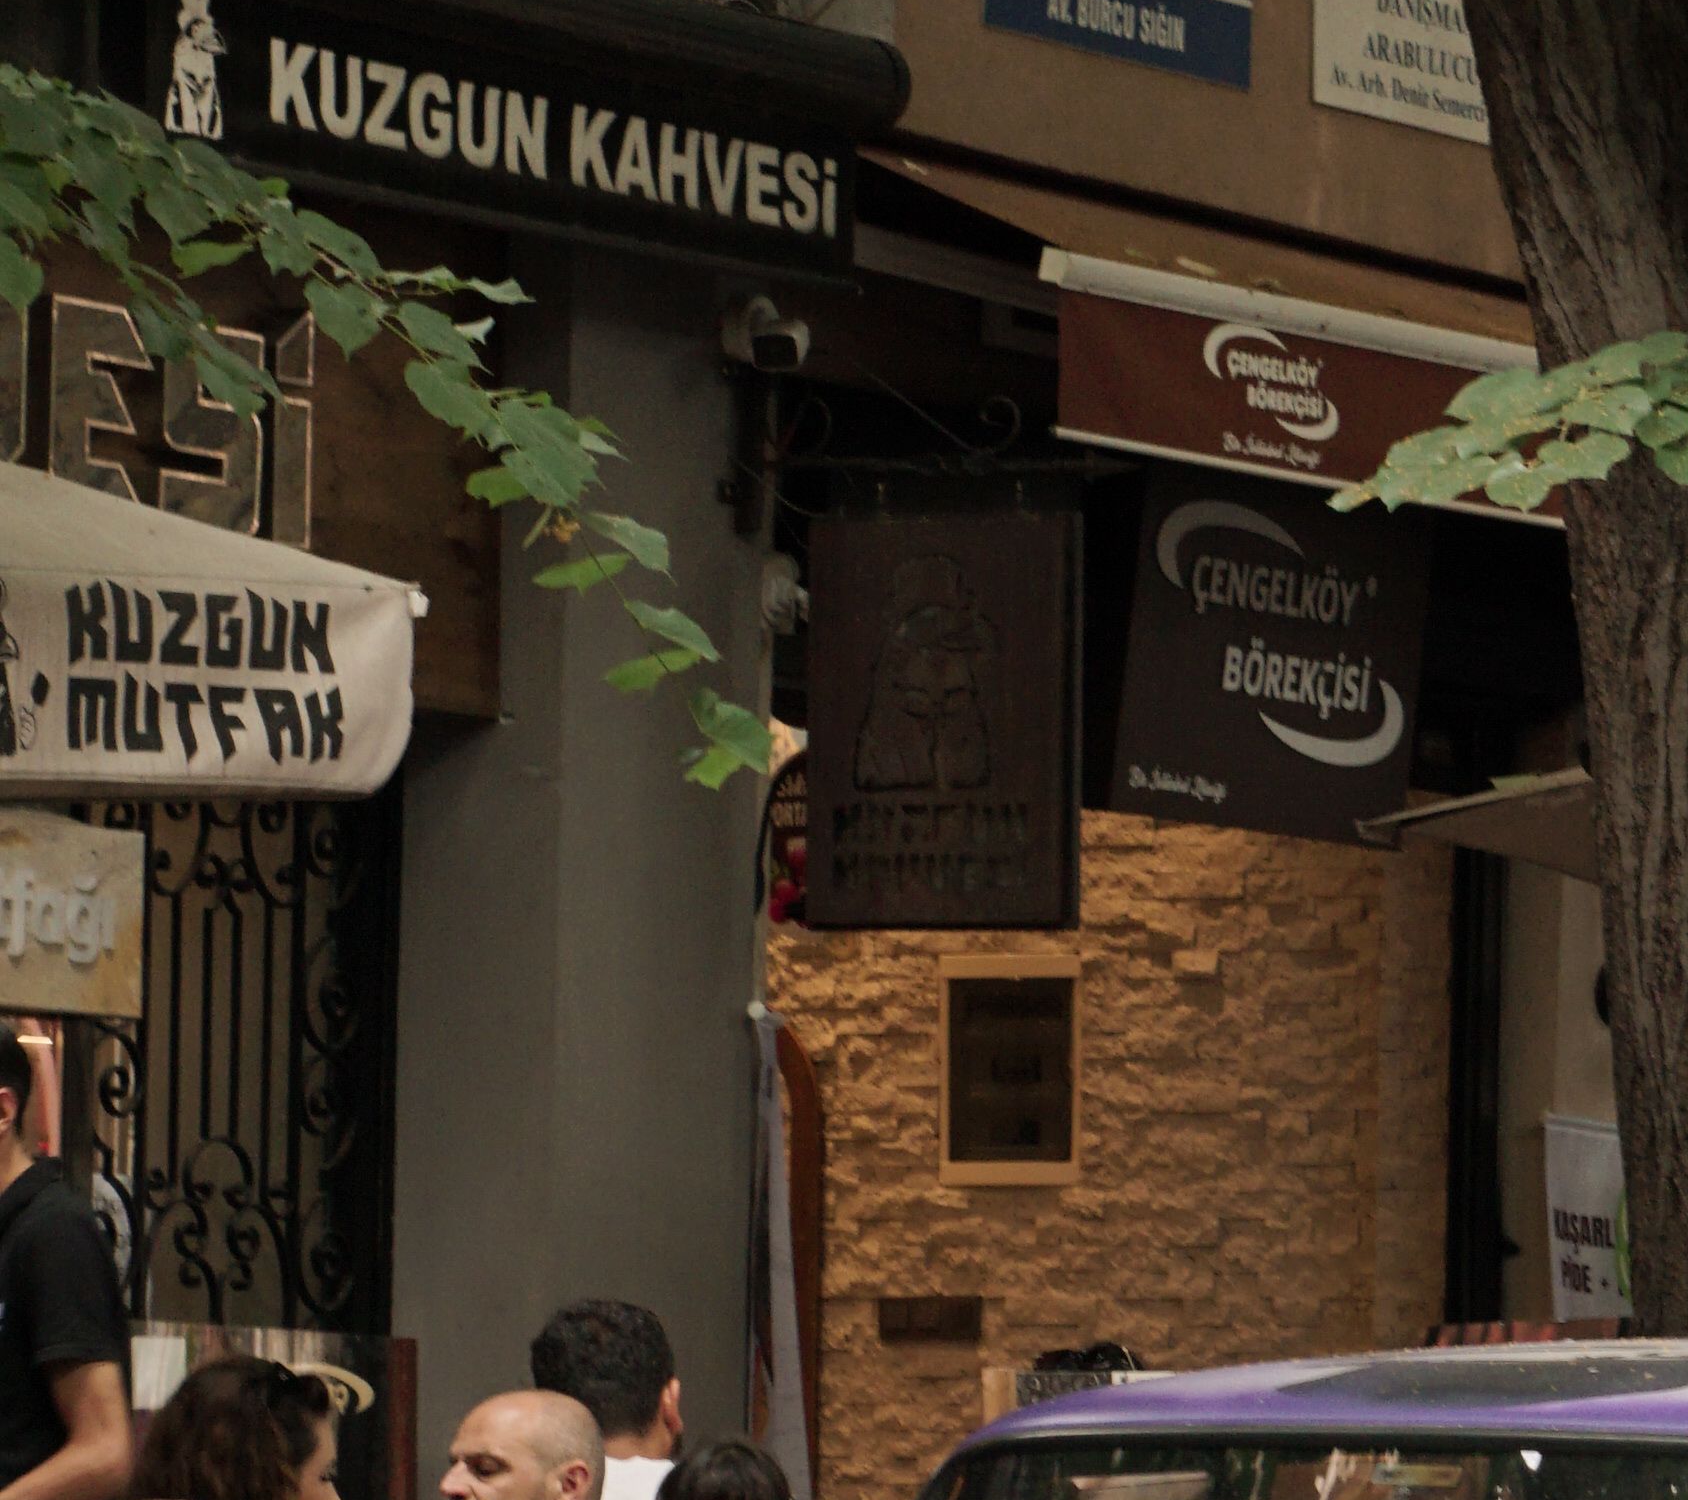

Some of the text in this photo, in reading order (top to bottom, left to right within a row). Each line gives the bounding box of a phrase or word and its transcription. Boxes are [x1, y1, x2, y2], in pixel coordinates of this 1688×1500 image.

[269, 37, 548, 181] KUZGUN
[1227, 349, 1319, 387] ÇENGELKÖY
[1247, 379, 1324, 420] BÖREKÇİSİ
[64, 578, 335, 674] KUZGUN
[1192, 555, 1360, 626] ÇENGELKÖY
[67, 671, 345, 765] MUTFAK
[1222, 635, 1372, 720] BÖREKÇİSİ
[0, 868, 119, 965] fağı
